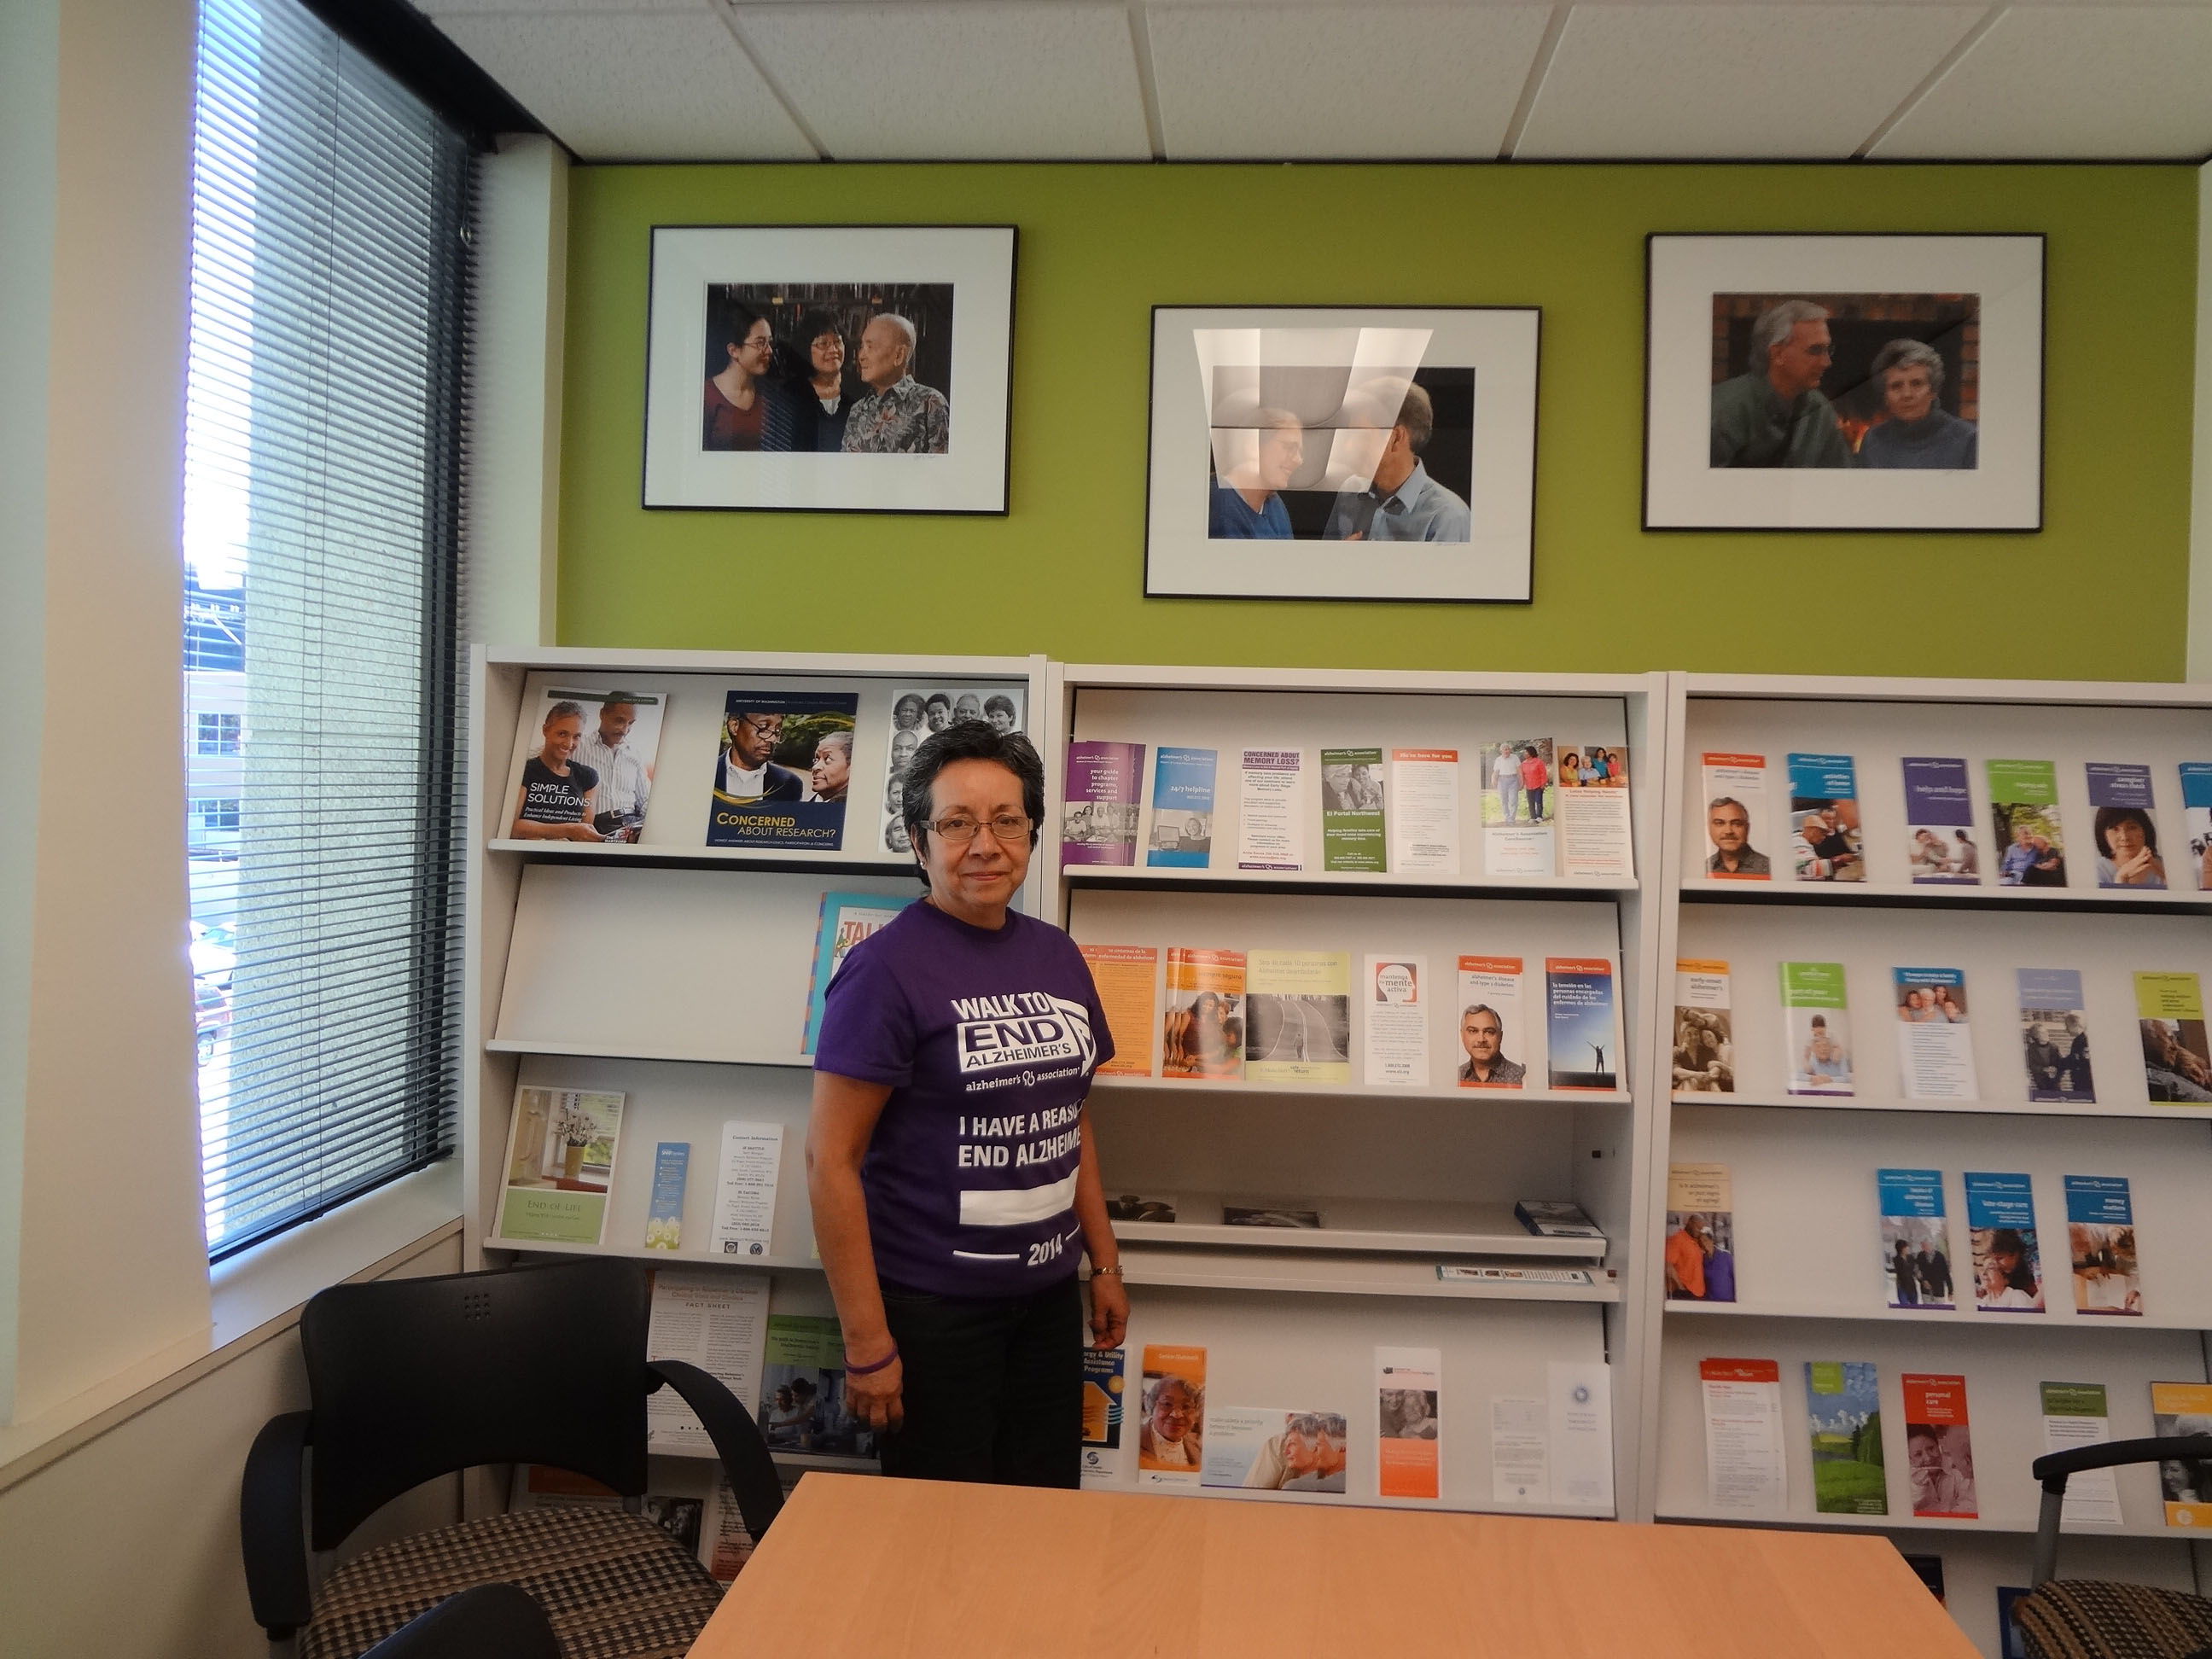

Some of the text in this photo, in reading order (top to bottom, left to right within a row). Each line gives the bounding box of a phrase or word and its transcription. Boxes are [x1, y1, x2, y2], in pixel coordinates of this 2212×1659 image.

[530, 783, 570, 795] SIMPLE
[1185, 785, 1212, 794] helpline
[737, 827, 836, 839] ABOUT RESEARCH?
[844, 921, 886, 945] TAL
[951, 992, 1051, 1020] WALK TO
[964, 1018, 1064, 1052] END
[966, 1042, 1072, 1068] ALZHEIMER'S
[965, 1067, 1081, 1091] alzheimer's association
[959, 1116, 966, 1136] I
[973, 1115, 1025, 1137] HAVE
[1029, 1112, 1040, 1133] A
[958, 1144, 1010, 1167] END
[1027, 1233, 1062, 1266] 2014
